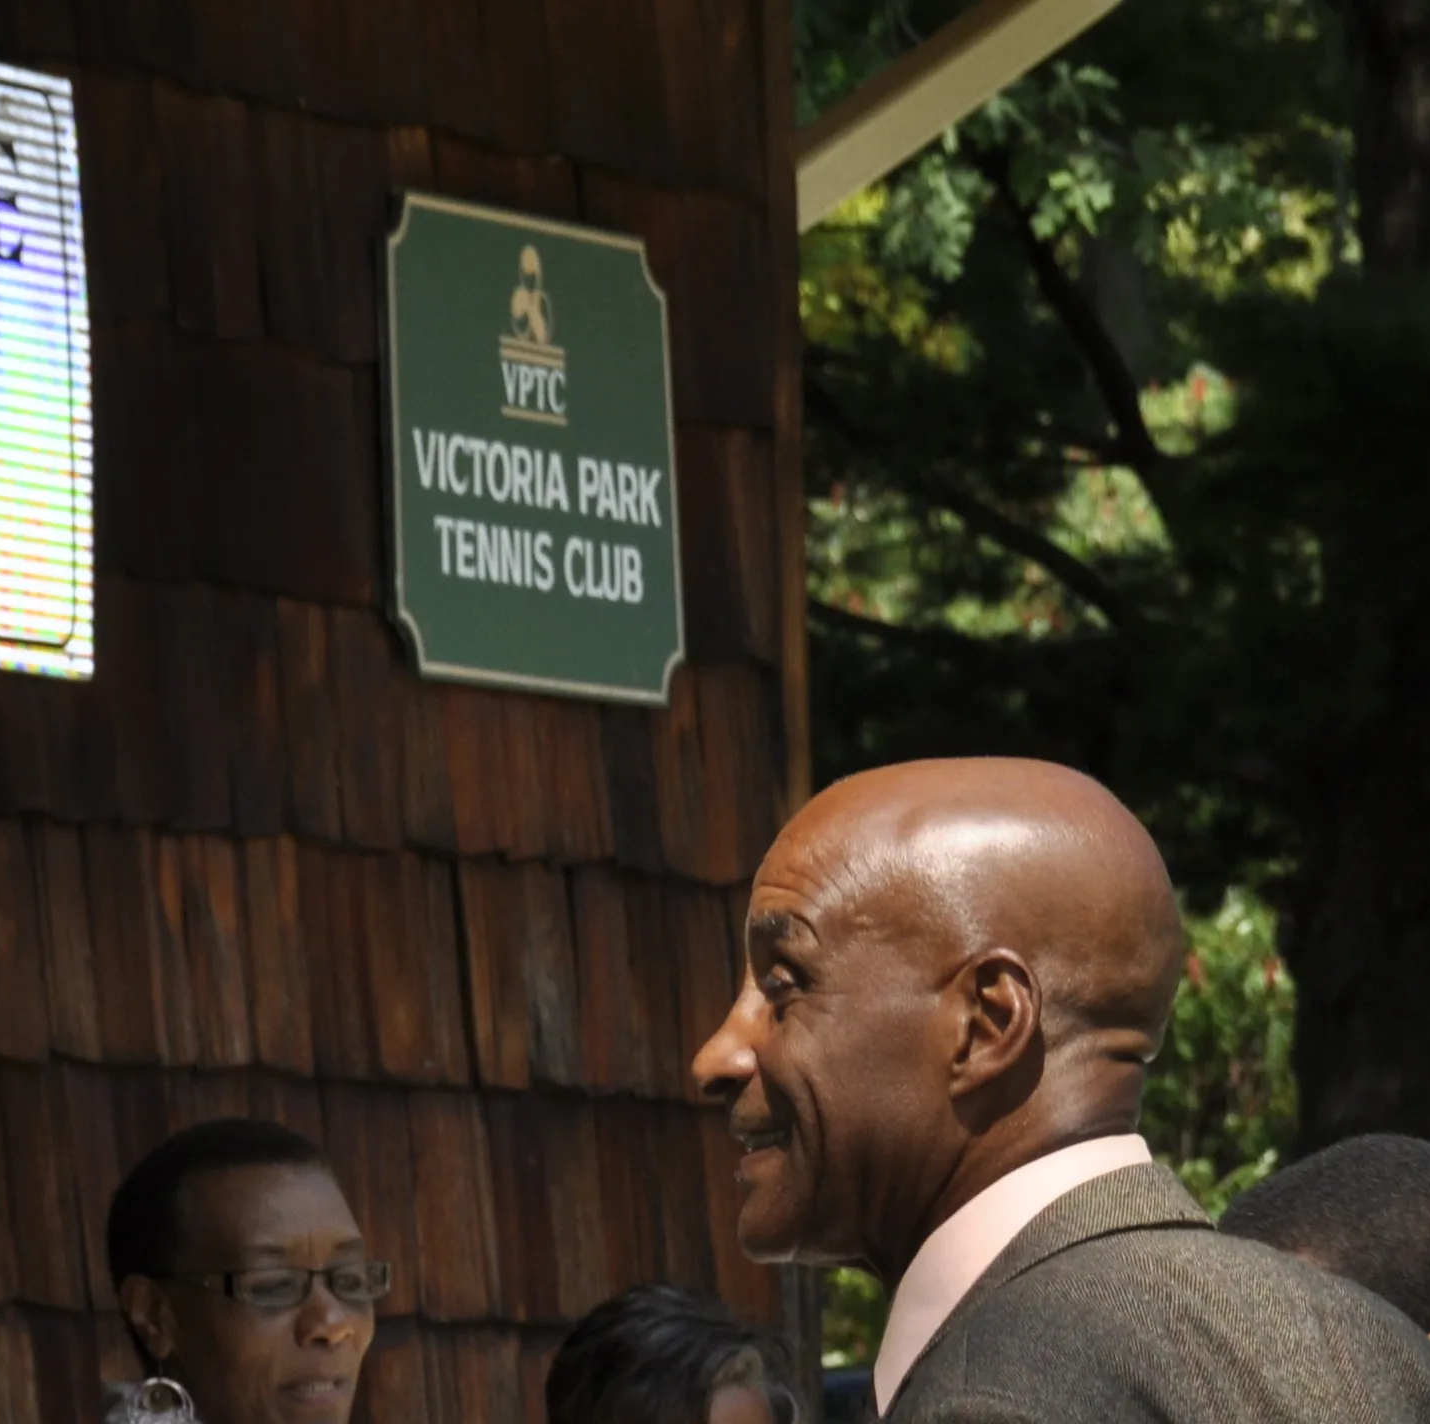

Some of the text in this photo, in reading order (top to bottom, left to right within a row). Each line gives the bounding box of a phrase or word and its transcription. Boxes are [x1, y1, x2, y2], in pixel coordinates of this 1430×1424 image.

[501, 360, 566, 414] VPTC
[412, 428, 663, 528] VICTORIA PARK
[434, 515, 644, 604] TENNIS CLUB
